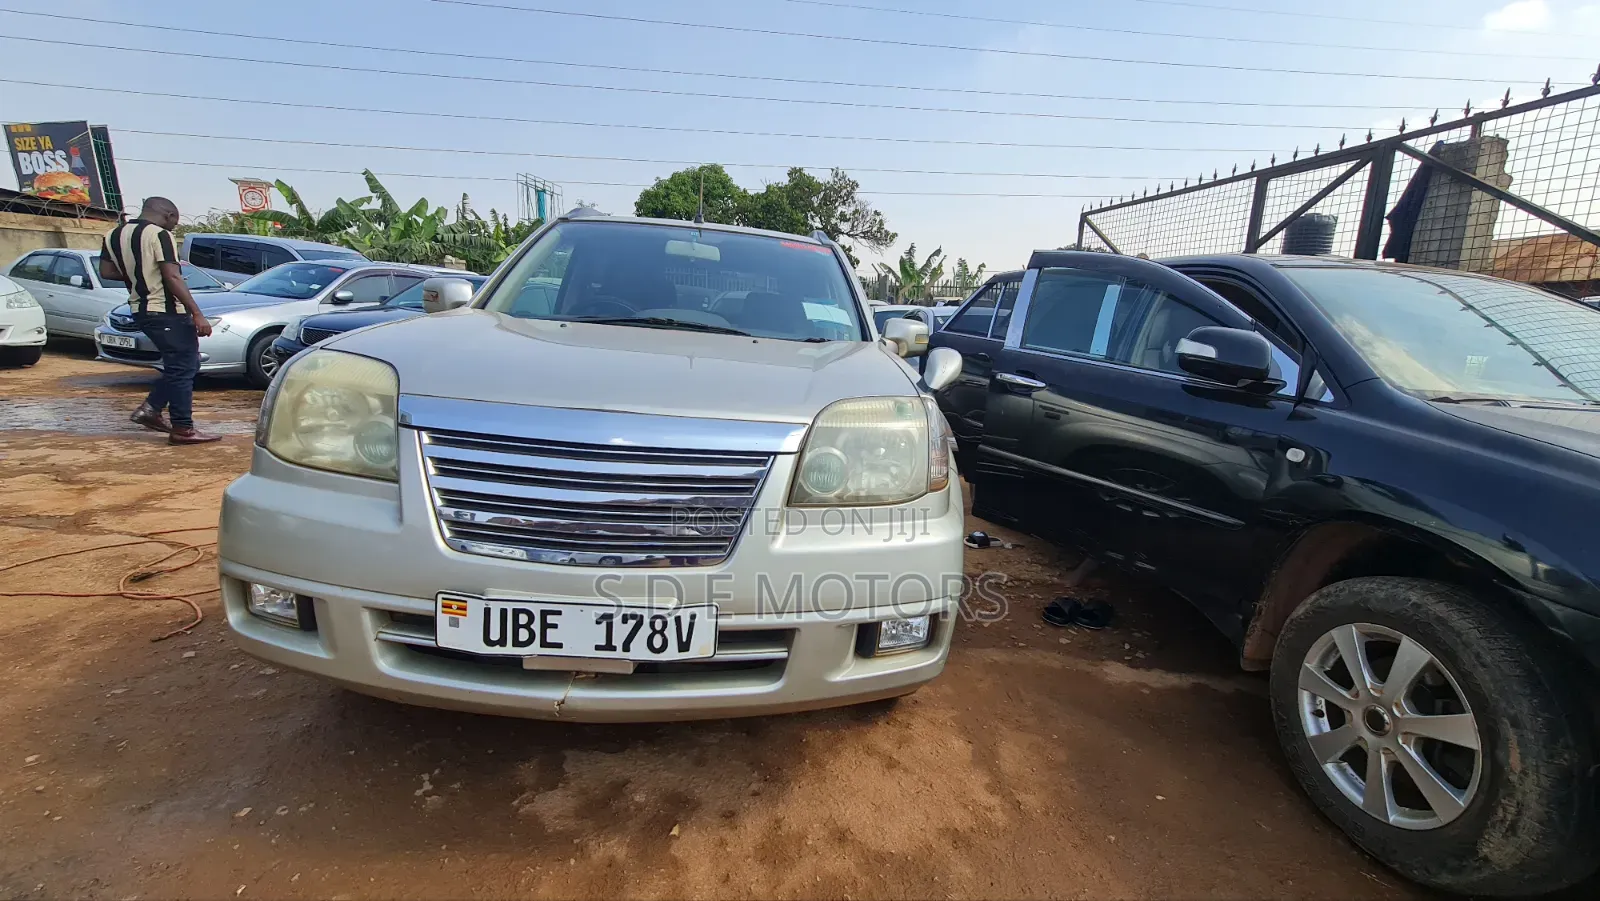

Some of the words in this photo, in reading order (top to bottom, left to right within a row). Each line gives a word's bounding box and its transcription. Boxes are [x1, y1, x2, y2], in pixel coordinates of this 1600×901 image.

[14, 136, 37, 151] SIZE
[37, 135, 53, 150] YA
[17, 149, 70, 175] BOSS
[482, 606, 563, 649] UBE
[594, 612, 697, 654] 178V
